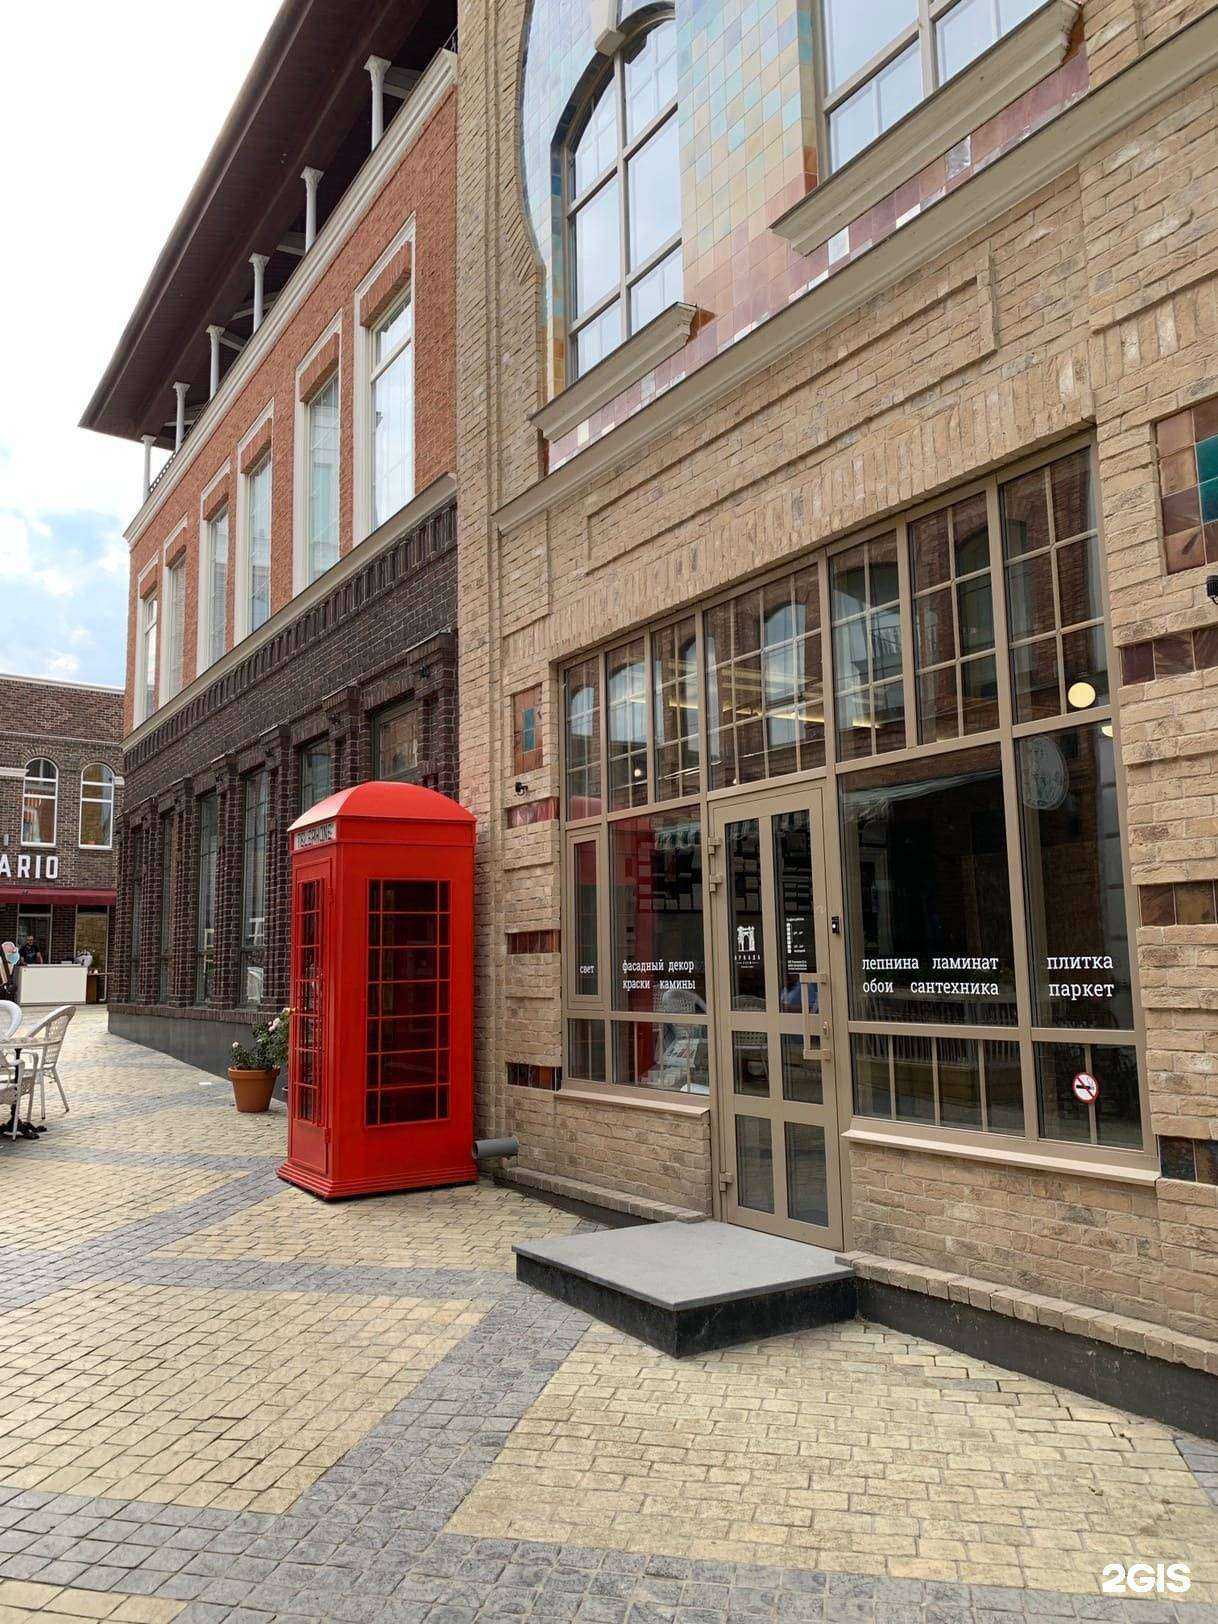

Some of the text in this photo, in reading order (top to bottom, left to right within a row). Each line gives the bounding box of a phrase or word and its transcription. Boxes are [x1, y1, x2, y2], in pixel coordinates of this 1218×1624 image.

[579, 964, 595, 975] свет
[622, 958, 694, 974] фасадный декор
[862, 956, 999, 971] лепнина ламинат
[1046, 954, 1114, 970] плитка
[622, 979, 696, 992] краски камины
[862, 978, 999, 996] обои сантехника
[1048, 982, 1115, 1001] паркет
